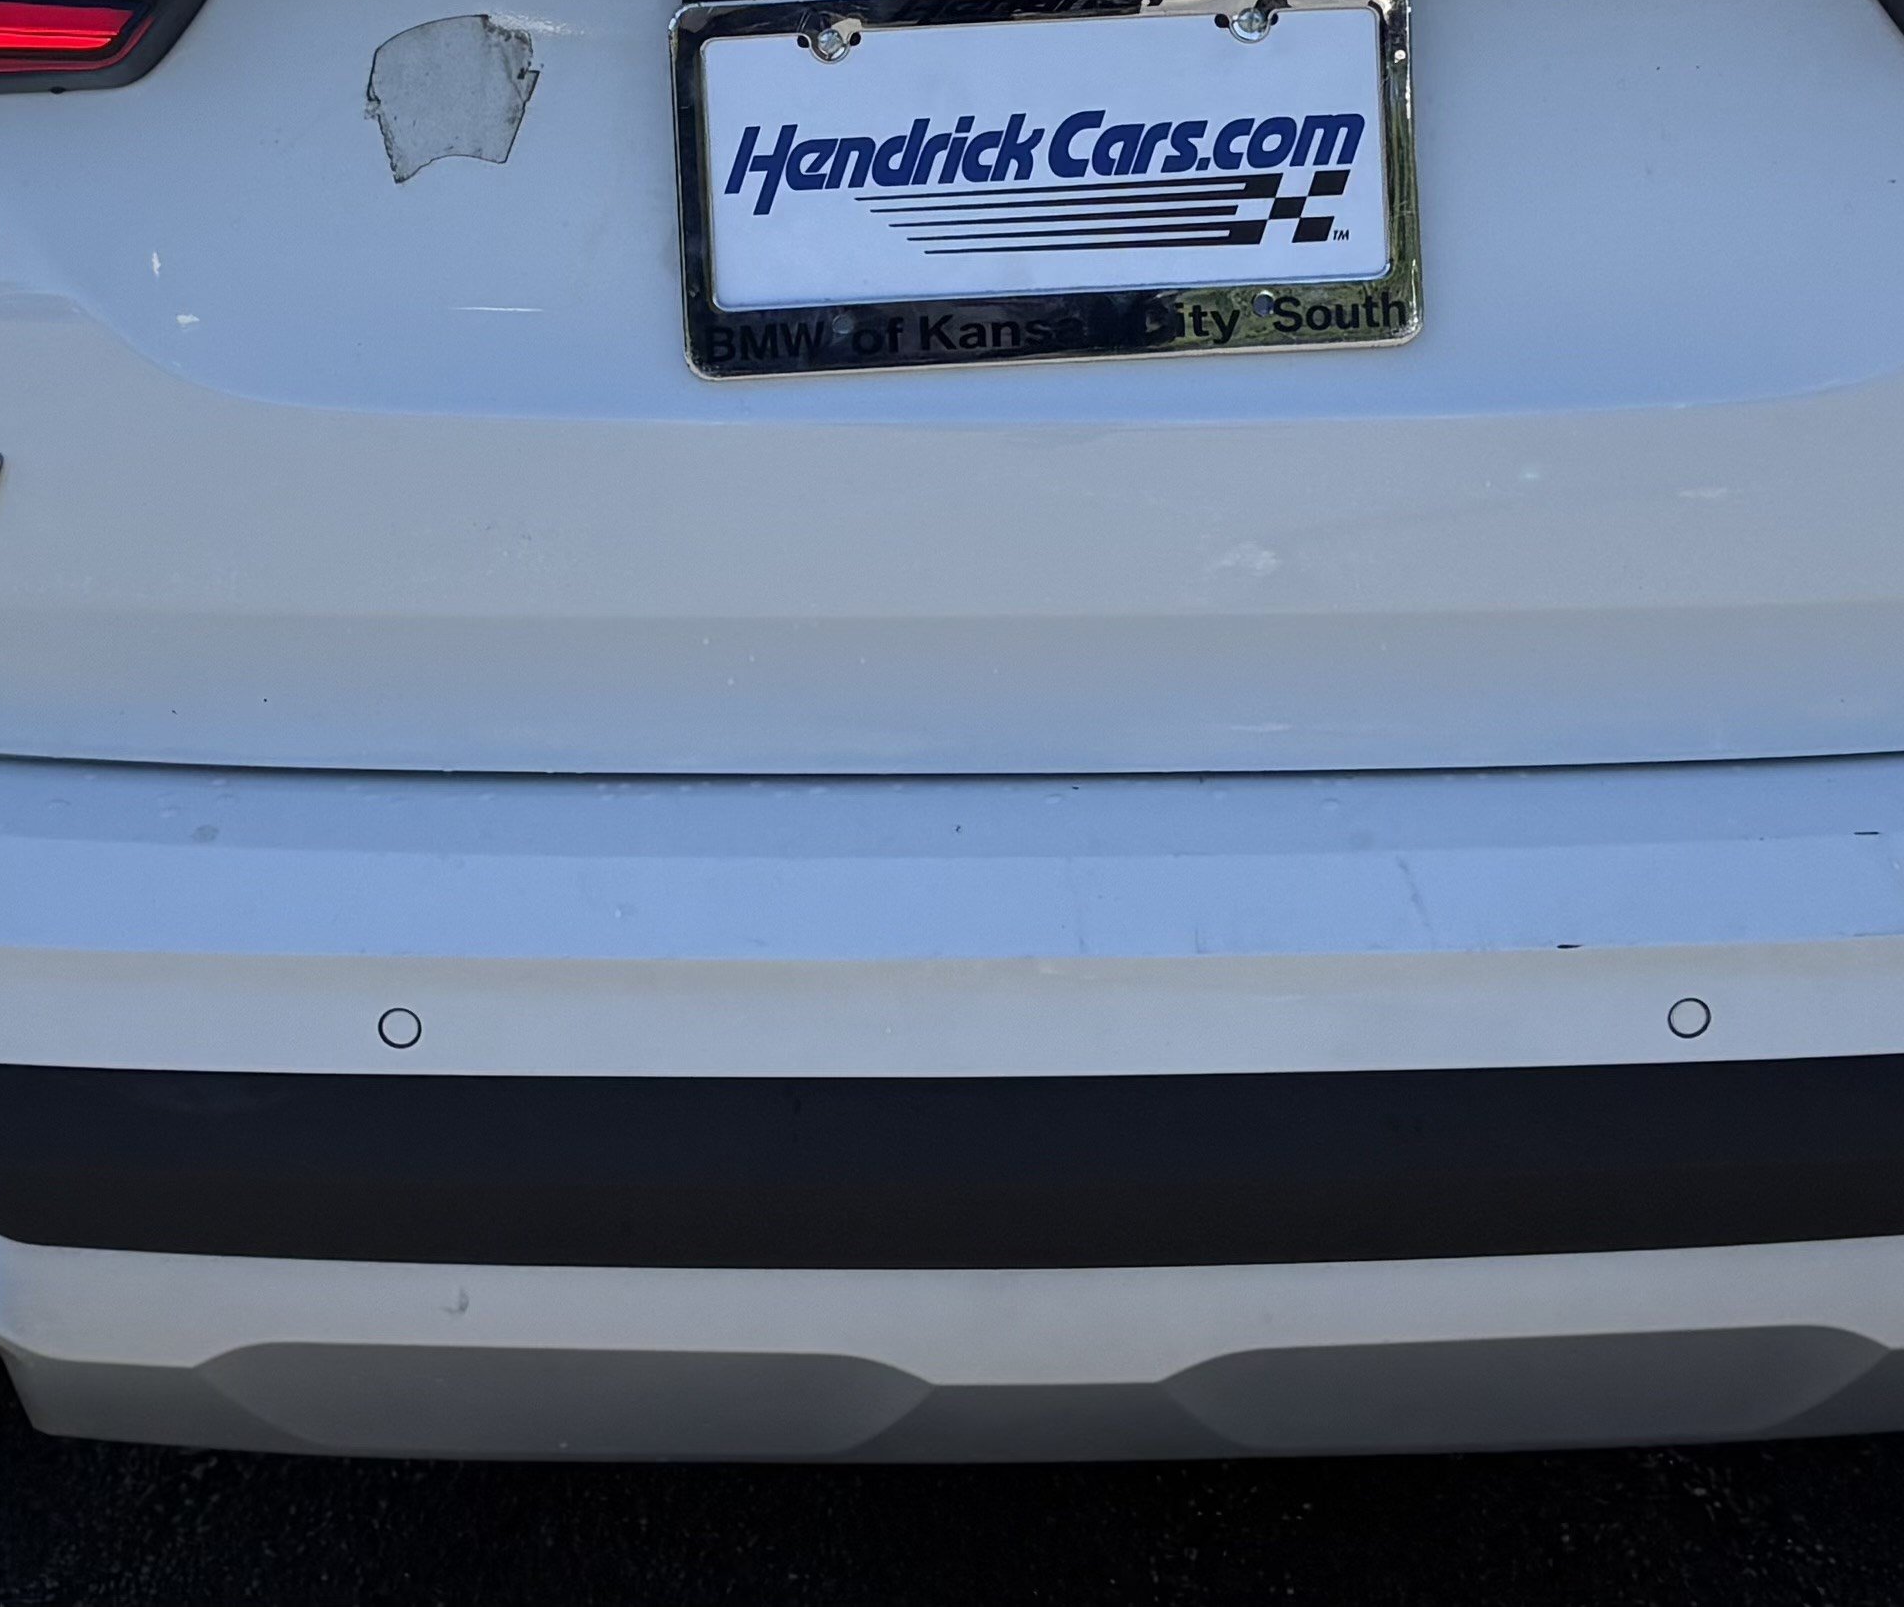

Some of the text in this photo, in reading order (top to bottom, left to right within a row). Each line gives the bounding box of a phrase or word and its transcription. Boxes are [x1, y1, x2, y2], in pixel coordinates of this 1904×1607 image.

[704, 320, 825, 364] BMW
[852, 318, 903, 353] of
[1273, 291, 1409, 335] South
